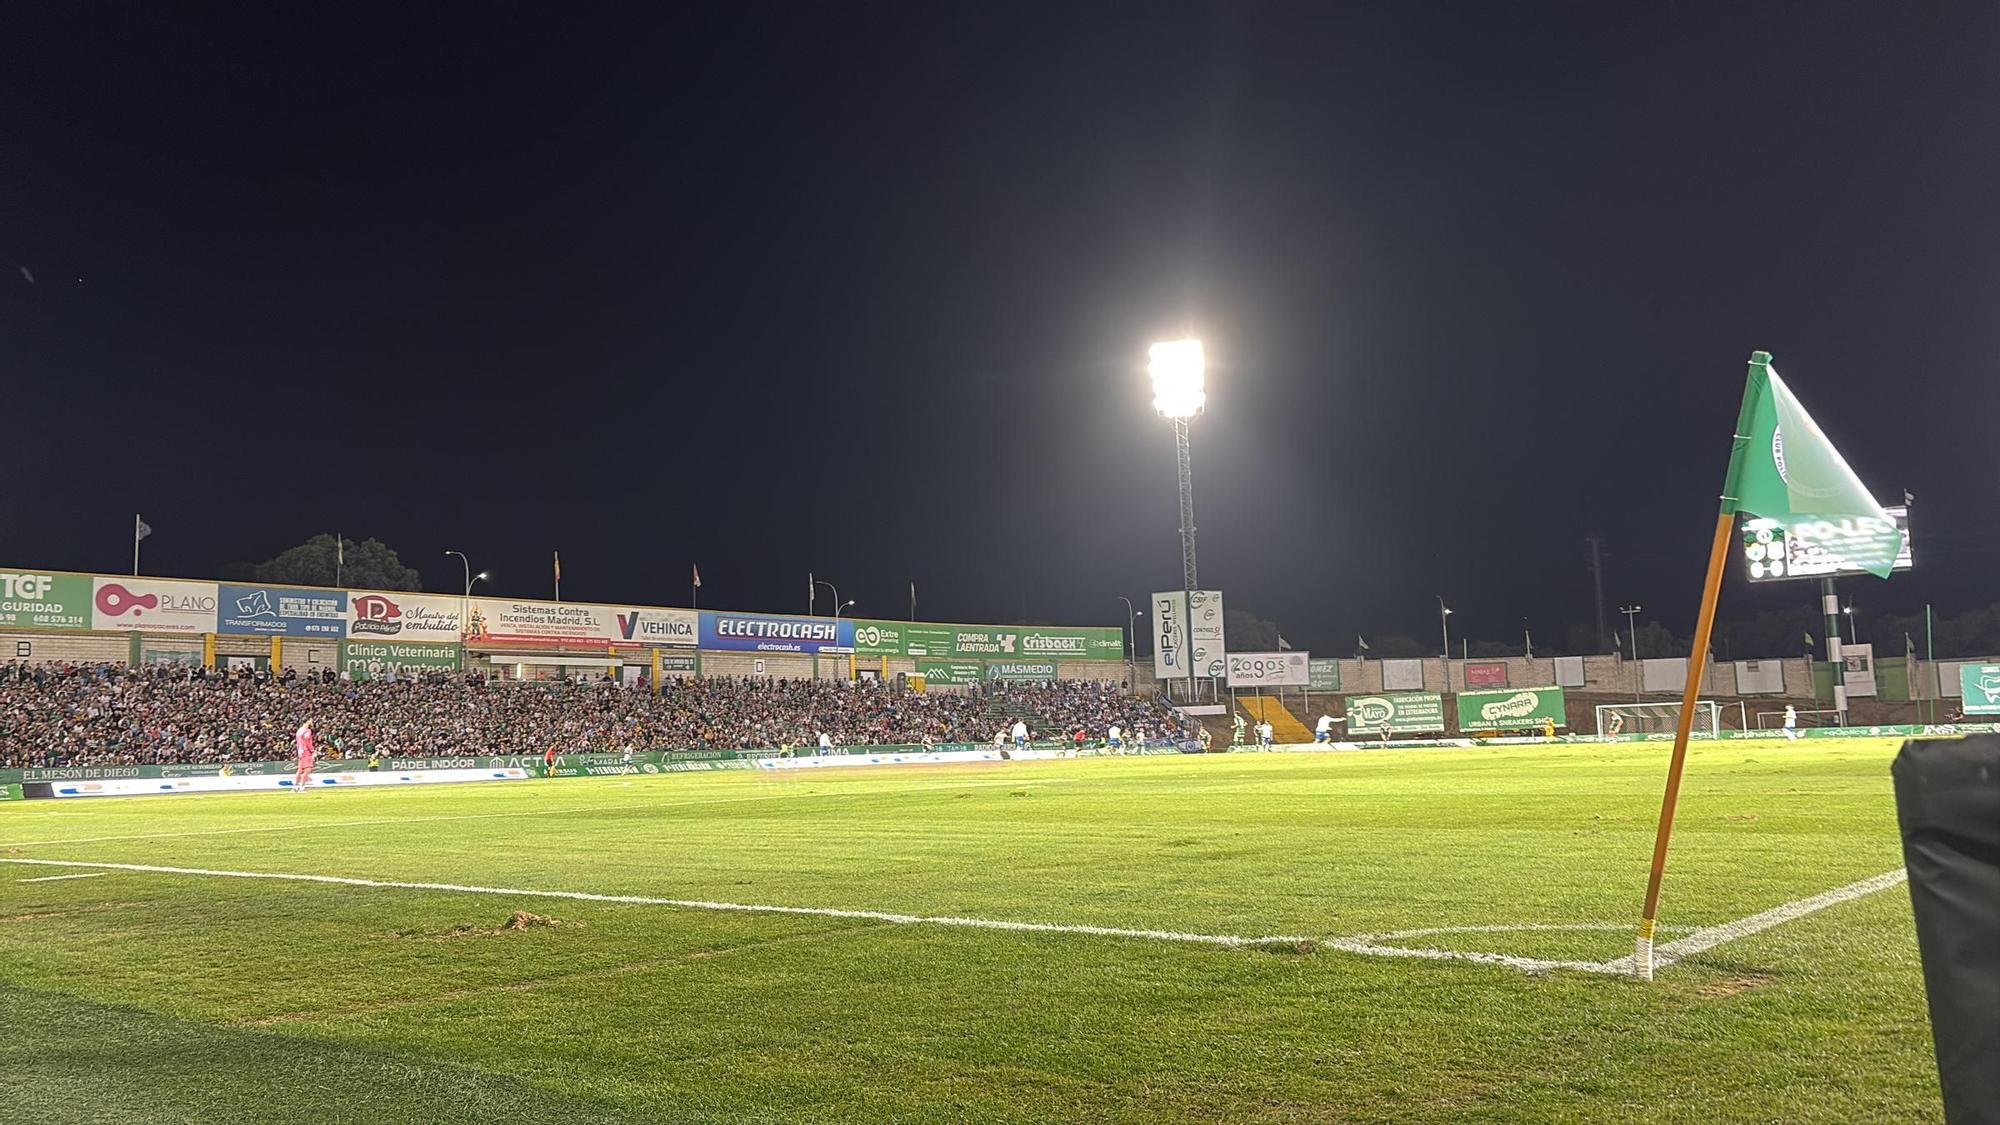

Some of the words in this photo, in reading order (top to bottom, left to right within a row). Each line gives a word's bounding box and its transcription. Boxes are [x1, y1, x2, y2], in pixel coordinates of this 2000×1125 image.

[0, 574, 53, 599] TCF
[161, 595, 216, 611] PLANO
[405, 607, 445, 620] Maestro
[446, 612, 460, 620] del
[512, 604, 556, 615] Sistemas
[558, 607, 590, 616] Contra
[224, 619, 288, 628] TRANSFORMADOS
[500, 613, 545, 623] Incendios
[405, 619, 460, 631] embutido
[641, 622, 693, 636] VEHINCA
[718, 619, 836, 639] ELECTROCASH
[881, 629, 899, 639] Extre
[957, 633, 989, 643] COMPRA
[17, 641, 31, 656] B
[347, 643, 387, 656] Clínica
[390, 645, 455, 658] Veterinaria
[757, 643, 801, 651] electrocash.es
[308, 649, 319, 663] C
[1001, 662, 1053, 674] MÁSMEDIO
[1488, 698, 1532, 715] CYNARA
[1362, 707, 1386, 719] MAYO
[392, 759, 430, 770] PÁDEL
[432, 759, 475, 769] INDOOR
[23, 770, 39, 780] EL
[42, 768, 83, 779] MESÓN
[86, 768, 102, 778] DE
[104, 767, 140, 778] DIEGO
